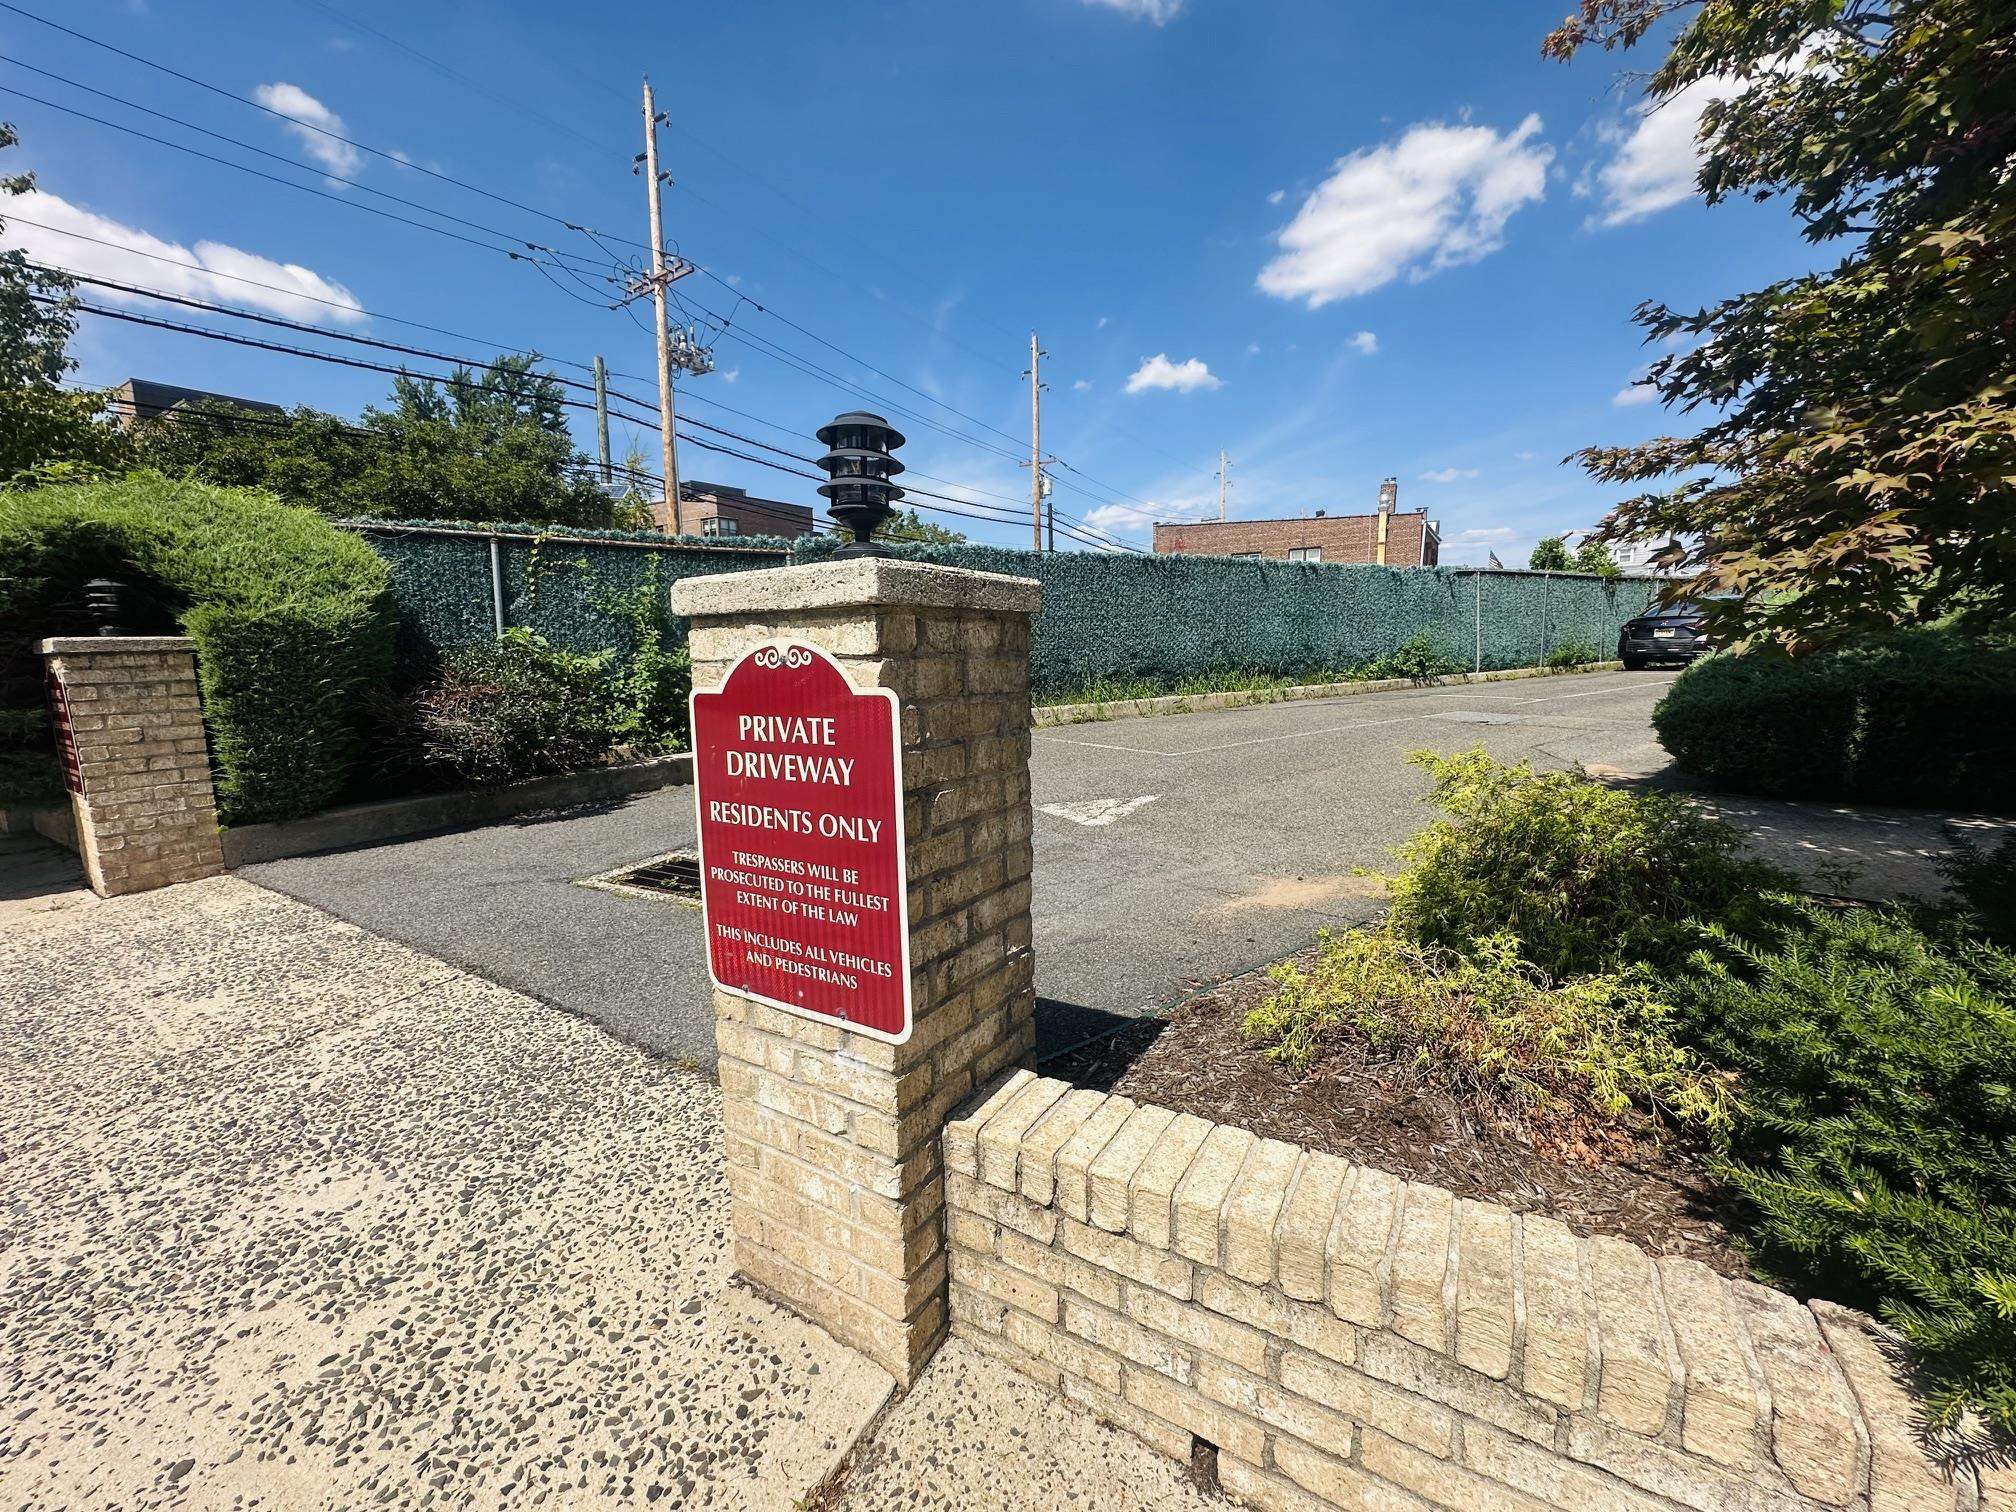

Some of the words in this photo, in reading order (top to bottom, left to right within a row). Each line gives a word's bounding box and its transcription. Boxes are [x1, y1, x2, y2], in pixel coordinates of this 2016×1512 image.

[739, 716, 836, 745] PRIVATE
[726, 751, 855, 785] DRIVEWAY
[710, 801, 812, 834] RESIDENTS
[819, 814, 881, 843] ONLY
[732, 851, 805, 876] TRESPASSERS
[807, 863, 839, 881] WILL
[843, 869, 859, 885] BE
[711, 867, 784, 892] PROSECUTED
[786, 880, 804, 896] TO
[805, 883, 831, 901] THE
[834, 889, 889, 912] FULLEST
[737, 891, 778, 911] EXTENT
[782, 900, 799, 915] OF
[800, 903, 826, 921] THE
[828, 909, 859, 927] LAW
[716, 924, 742, 941] THIS
[743, 929, 802, 956] INCLUDES
[805, 945, 828, 962] ALL
[829, 949, 892, 978] VEHICLES
[746, 950, 773, 968] AND
[775, 957, 857, 990] PEDESTRIANS
